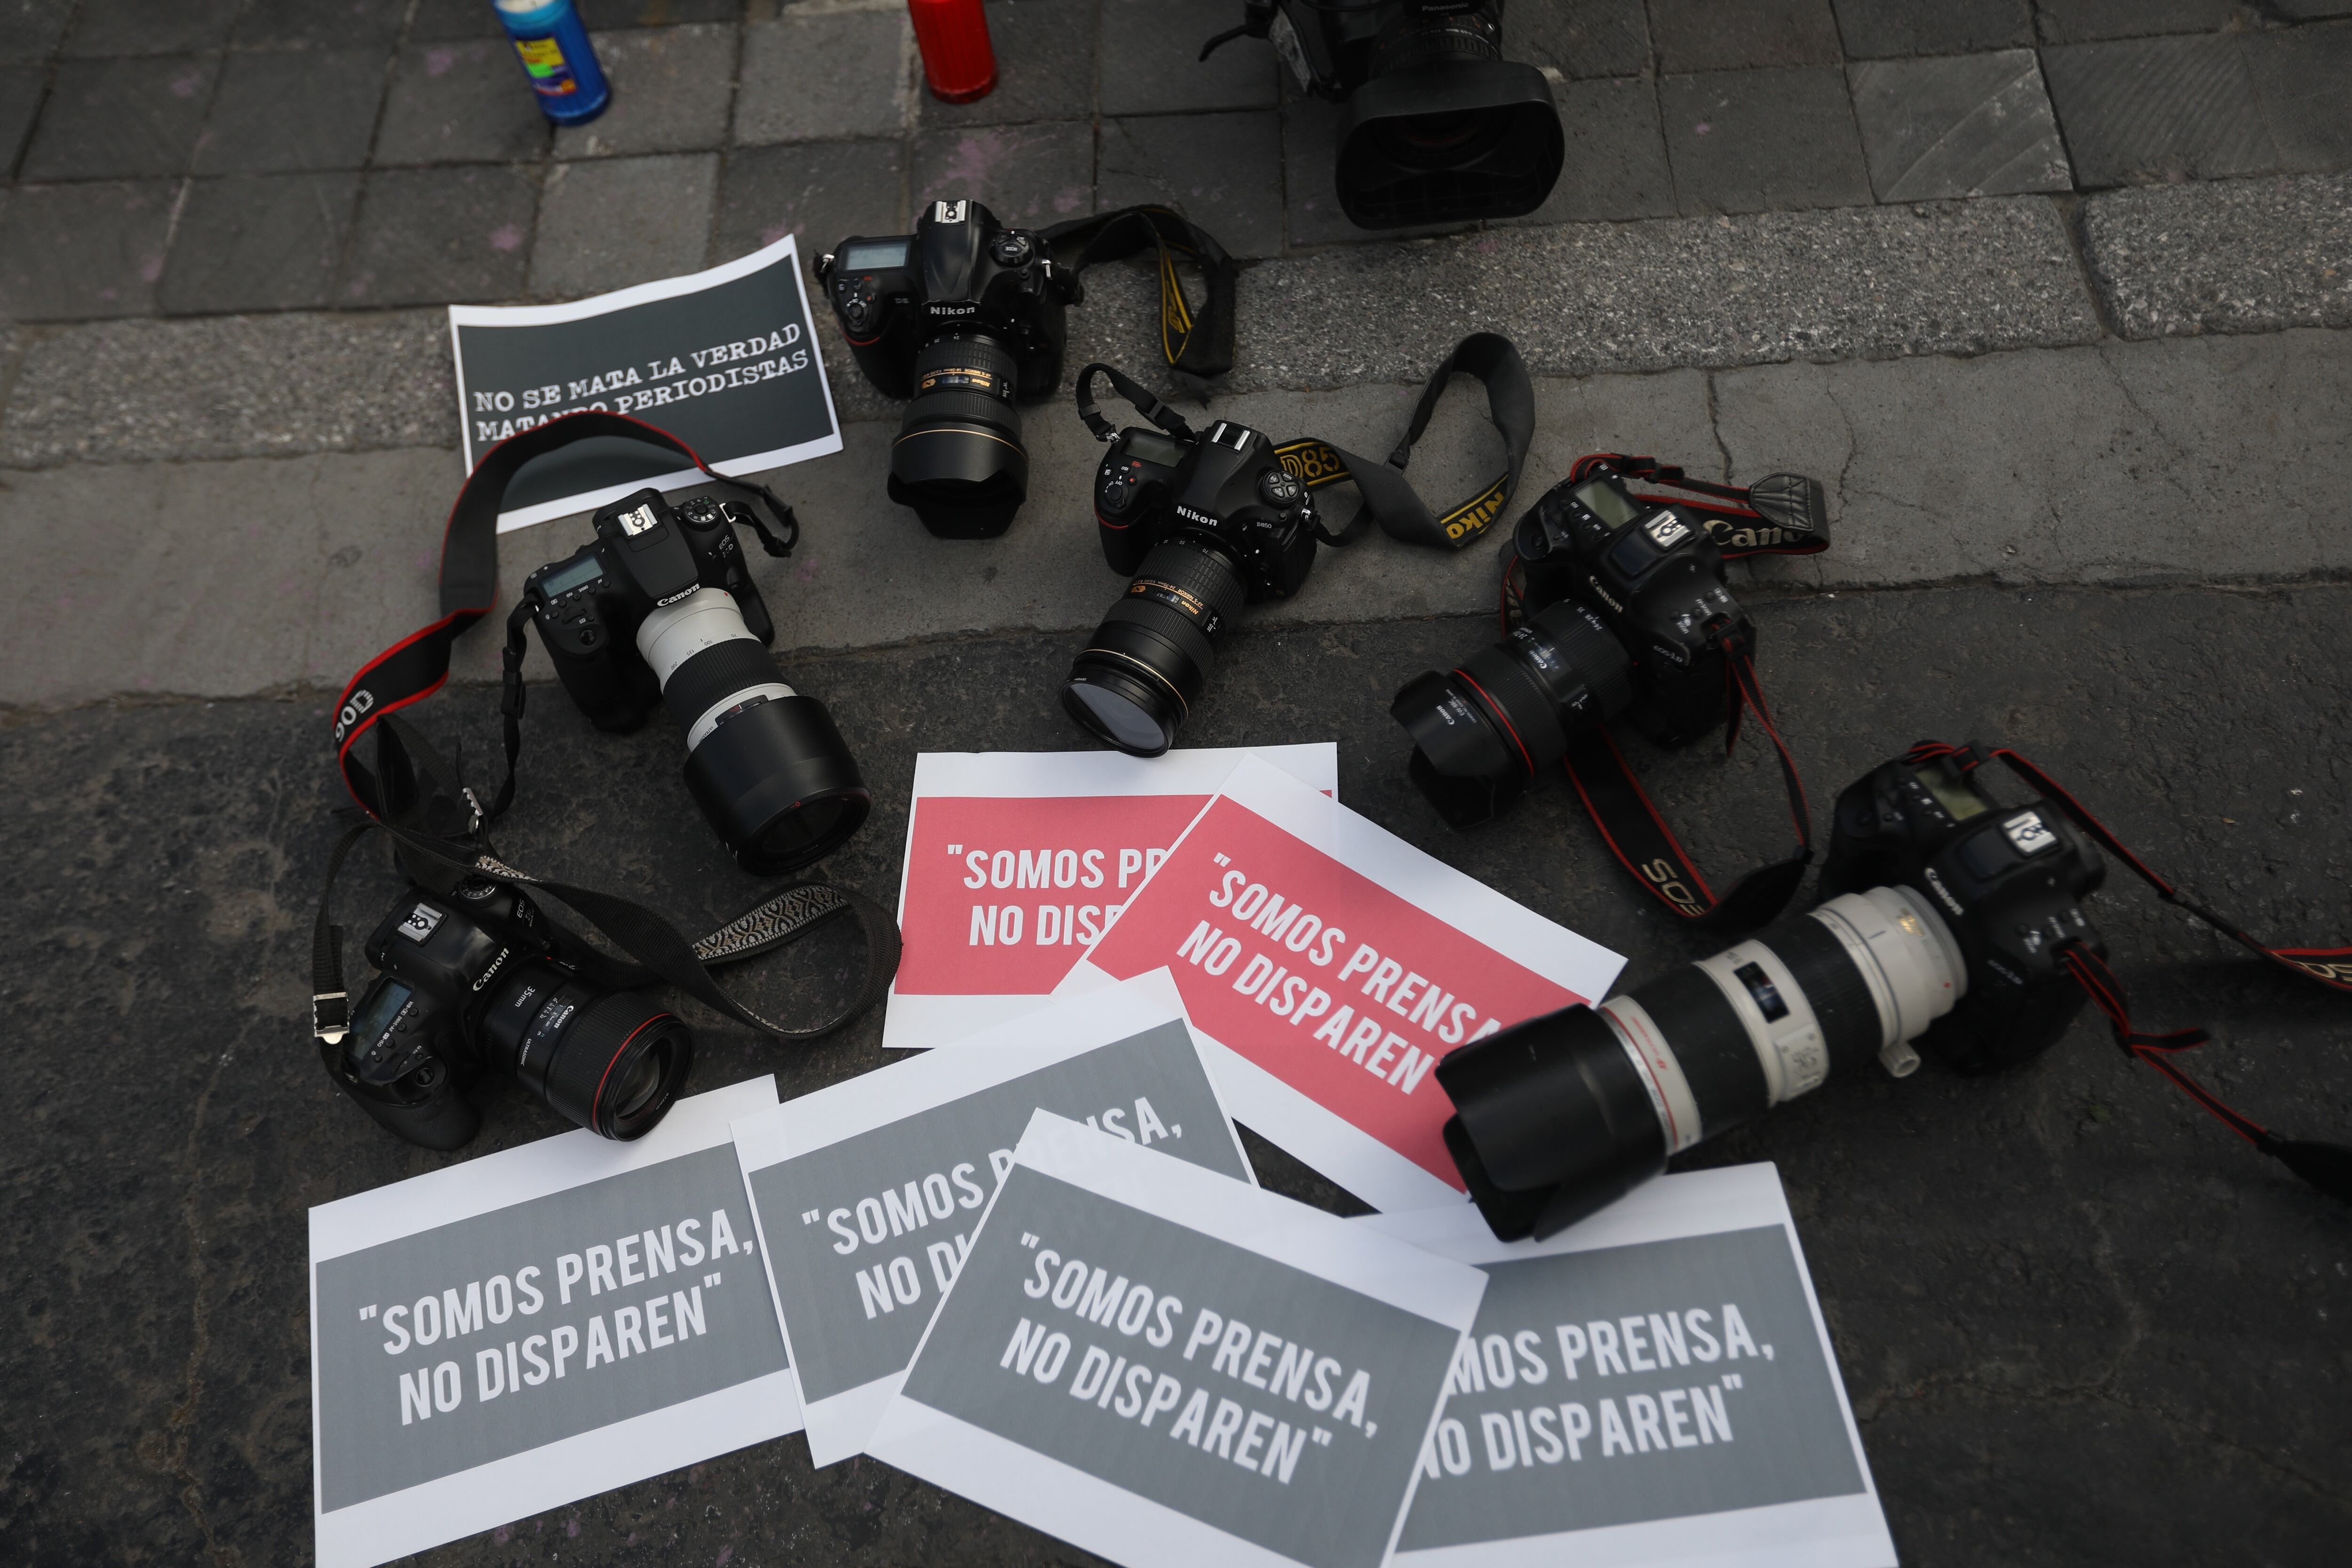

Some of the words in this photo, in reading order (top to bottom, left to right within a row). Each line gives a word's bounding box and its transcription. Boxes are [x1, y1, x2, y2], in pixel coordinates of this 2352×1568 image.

[1422, 3, 1470, 12] Panasonic
[930, 306, 976, 316] Nikon
[474, 391, 514, 412] NO
[523, 385, 561, 410] SE
[568, 367, 642, 401] MATA
[648, 356, 685, 381] LA
[690, 323, 801, 368] VERDAD
[614, 349, 809, 415] PERIODISTAS
[971, 378, 991, 387] Nikon
[1176, 505, 1218, 526] Nikon
[1446, 492, 1505, 539] Niko
[719, 535, 730, 549] EOS
[657, 583, 700, 606] Canon
[1177, 588, 1194, 600] NIKKOR
[1181, 600, 1199, 615] Nikon
[1590, 575, 1623, 613] Canon
[1528, 650, 1548, 669] Canon
[335, 690, 374, 743] 90D
[1436, 705, 1455, 725] Canon
[1448, 699, 1465, 716] EW-88C
[947, 844, 1105, 889] "SOMOS
[969, 905, 1024, 946] NO
[1209, 852, 1346, 966] "SOMOS
[473, 947, 509, 991] Canon
[515, 986, 536, 1008] 35mm
[554, 1005, 574, 1029] Canon
[1176, 920, 1242, 976] NO
[1232, 953, 1435, 1095] DISPAREN
[520, 1038, 532, 1067] ULTRASONIC
[802, 1162, 984, 1254] "SOMOS
[358, 1266, 544, 1355] "SOMOS
[556, 1209, 754, 1305] PRENSA,
[855, 1256, 921, 1320] NO
[399, 1361, 462, 1426] NO
[476, 1272, 722, 1402] DISPAREN"
[1020, 1231, 1183, 1348] "SOMOS
[1183, 1308, 1378, 1439] PRENSA,
[1556, 1304, 1775, 1380] PRENSA,
[1000, 1318, 1071, 1385] NO
[1069, 1345, 1333, 1485] DISPAREN"
[1480, 1374, 1744, 1471] DISPAREN"
